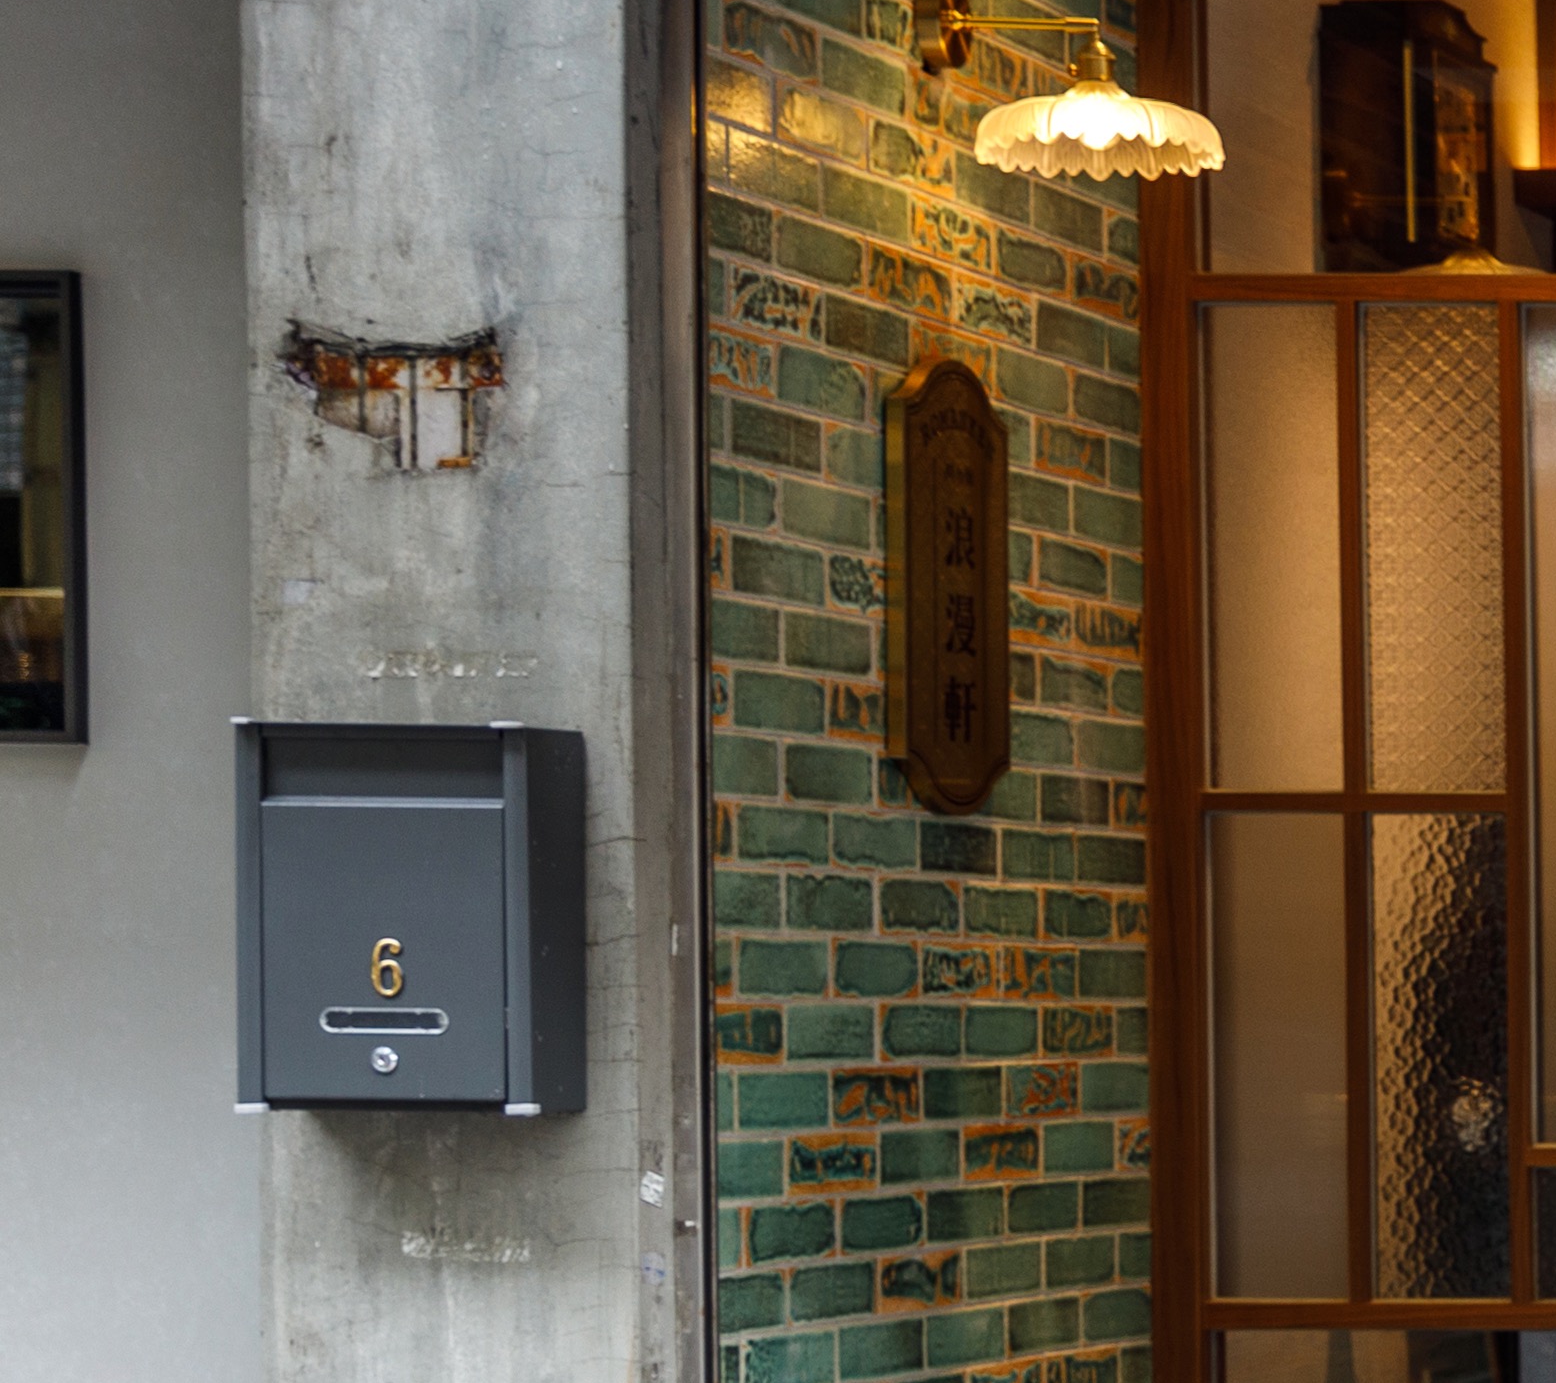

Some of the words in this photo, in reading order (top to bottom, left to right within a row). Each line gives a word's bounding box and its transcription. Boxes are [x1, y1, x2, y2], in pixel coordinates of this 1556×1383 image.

[943, 506, 978, 745] 浪漫軒
[370, 937, 404, 998] 6
